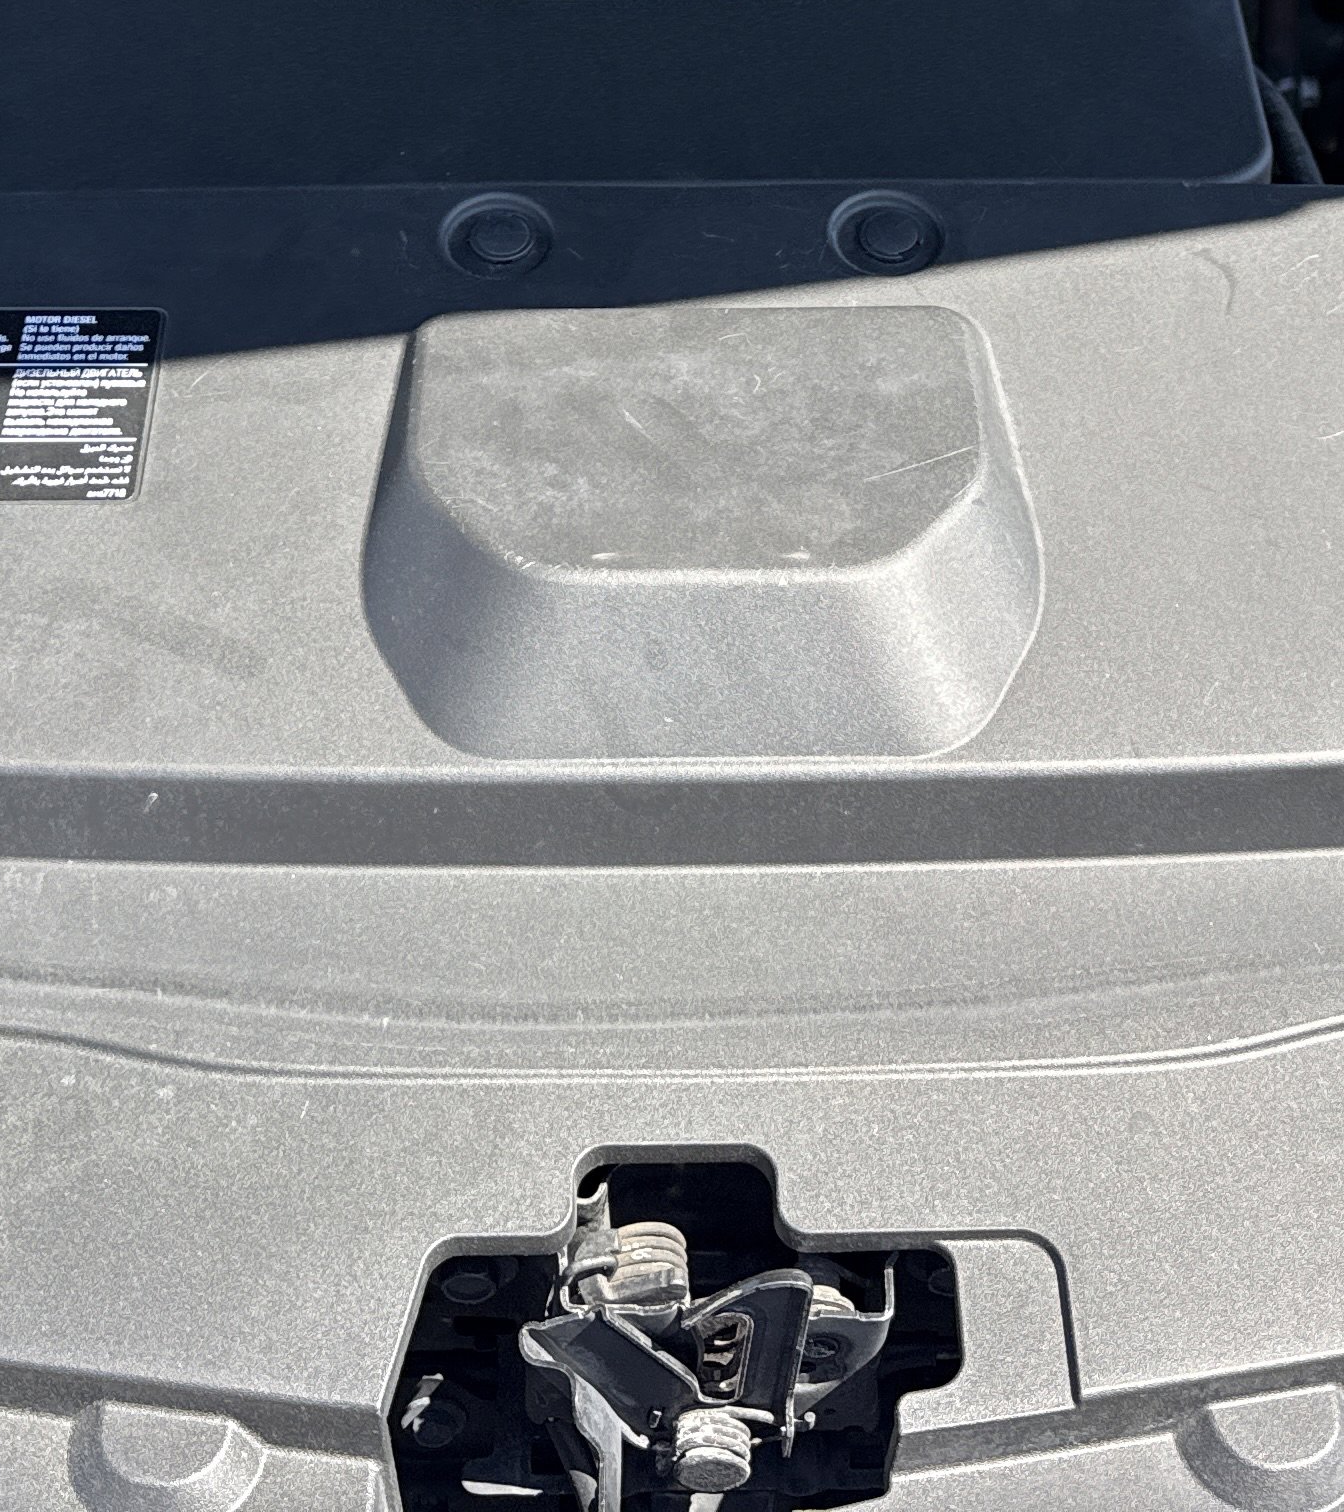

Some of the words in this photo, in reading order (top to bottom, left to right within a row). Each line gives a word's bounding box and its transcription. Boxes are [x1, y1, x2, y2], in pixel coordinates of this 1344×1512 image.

[24, 315, 61, 324] MOTOR
[62, 315, 98, 324] DIESEL
[21, 334, 35, 342] No
[91, 334, 104, 342] de
[19, 344, 33, 352] Se
[72, 353, 85, 361] en
